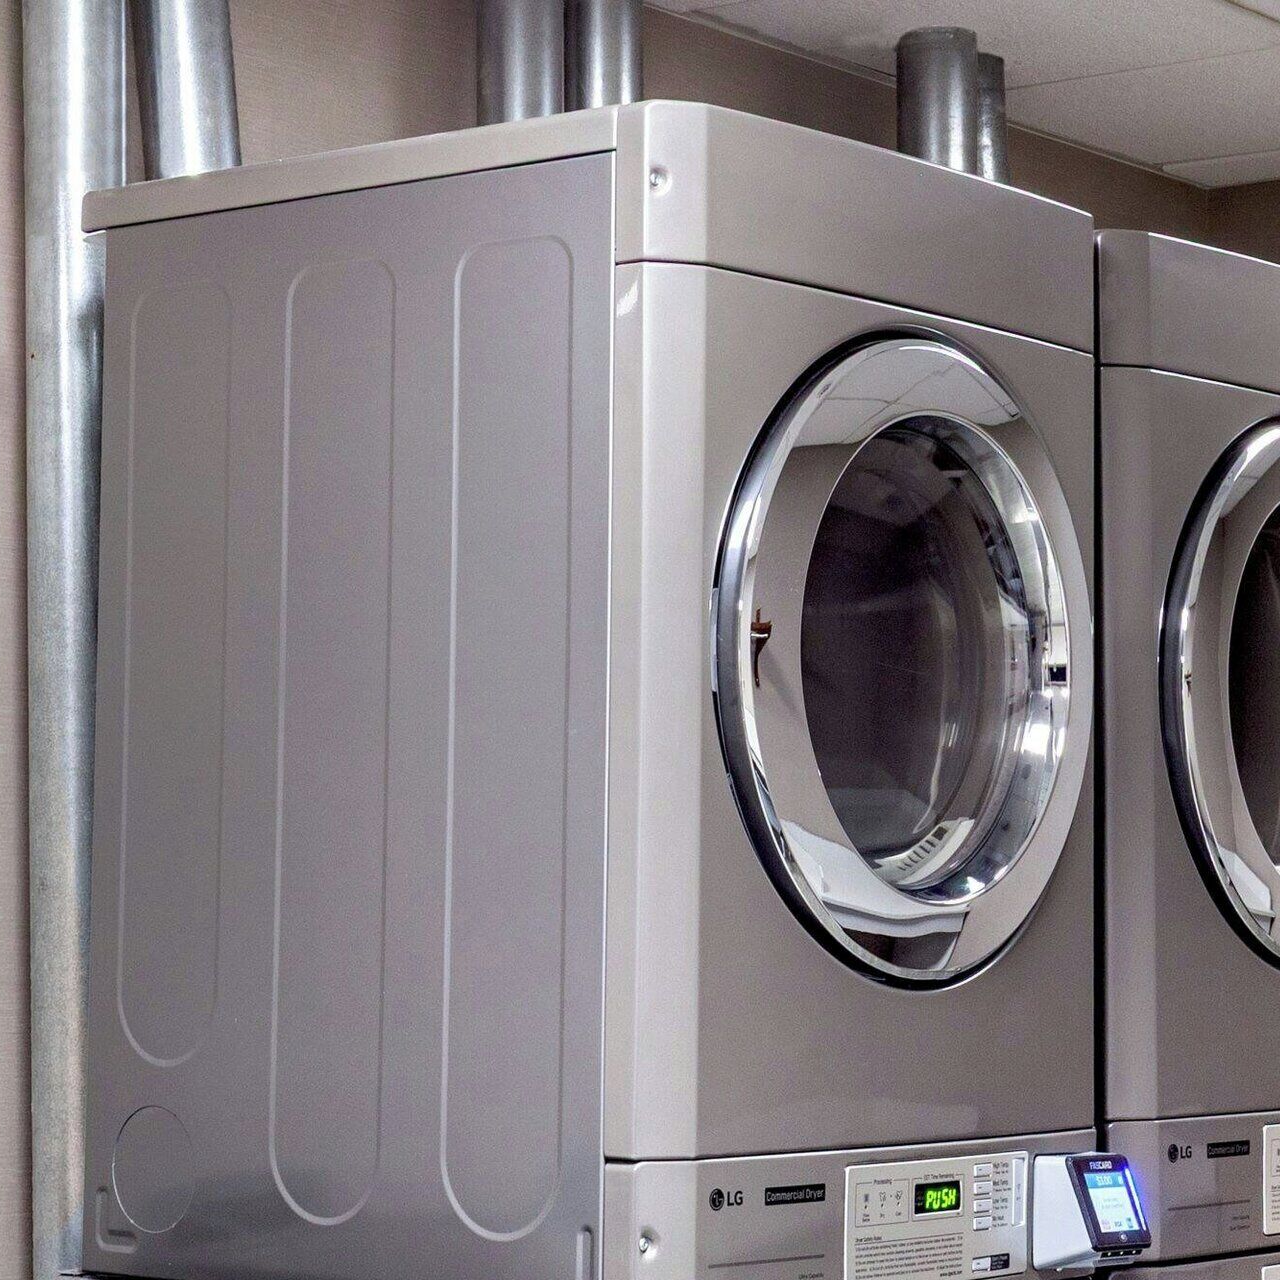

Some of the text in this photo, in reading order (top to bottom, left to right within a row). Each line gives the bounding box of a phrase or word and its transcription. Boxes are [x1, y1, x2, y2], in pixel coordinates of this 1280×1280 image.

[1180, 1146, 1192, 1158] LG
[727, 1191, 743, 1206] LG
[766, 1188, 824, 1202] Commercial Dryer
[926, 1189, 956, 1209] PUSH
